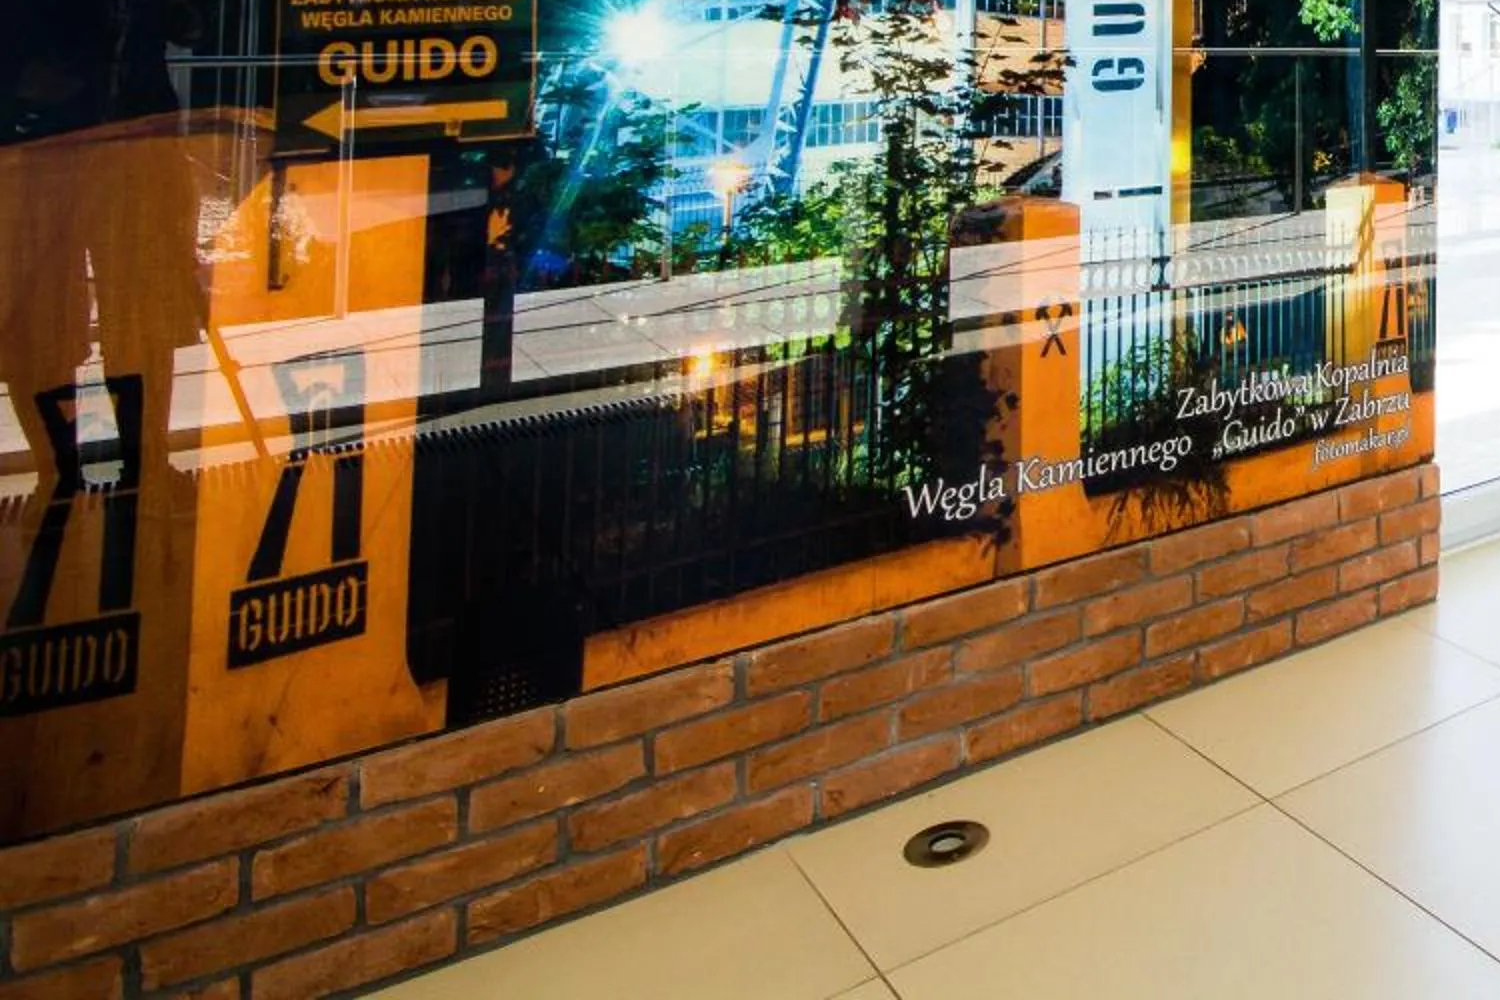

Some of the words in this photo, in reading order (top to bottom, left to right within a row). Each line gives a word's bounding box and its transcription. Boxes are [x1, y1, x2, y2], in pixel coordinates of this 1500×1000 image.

[302, 9, 372, 31] WĘGLA
[380, 5, 512, 26] KAMIENNEGO
[318, 35, 497, 86] GUIDO
[1176, 373, 1308, 420] Zabytkowa
[1314, 344, 1409, 395] Kopalnia
[903, 463, 1005, 521] Węgla
[1016, 435, 1192, 494] Kamiennego
[1310, 409, 1330, 432] w
[1334, 388, 1410, 425] Zabrzu
[237, 574, 361, 653] GUIDO
[0, 628, 129, 702] GUIDO
